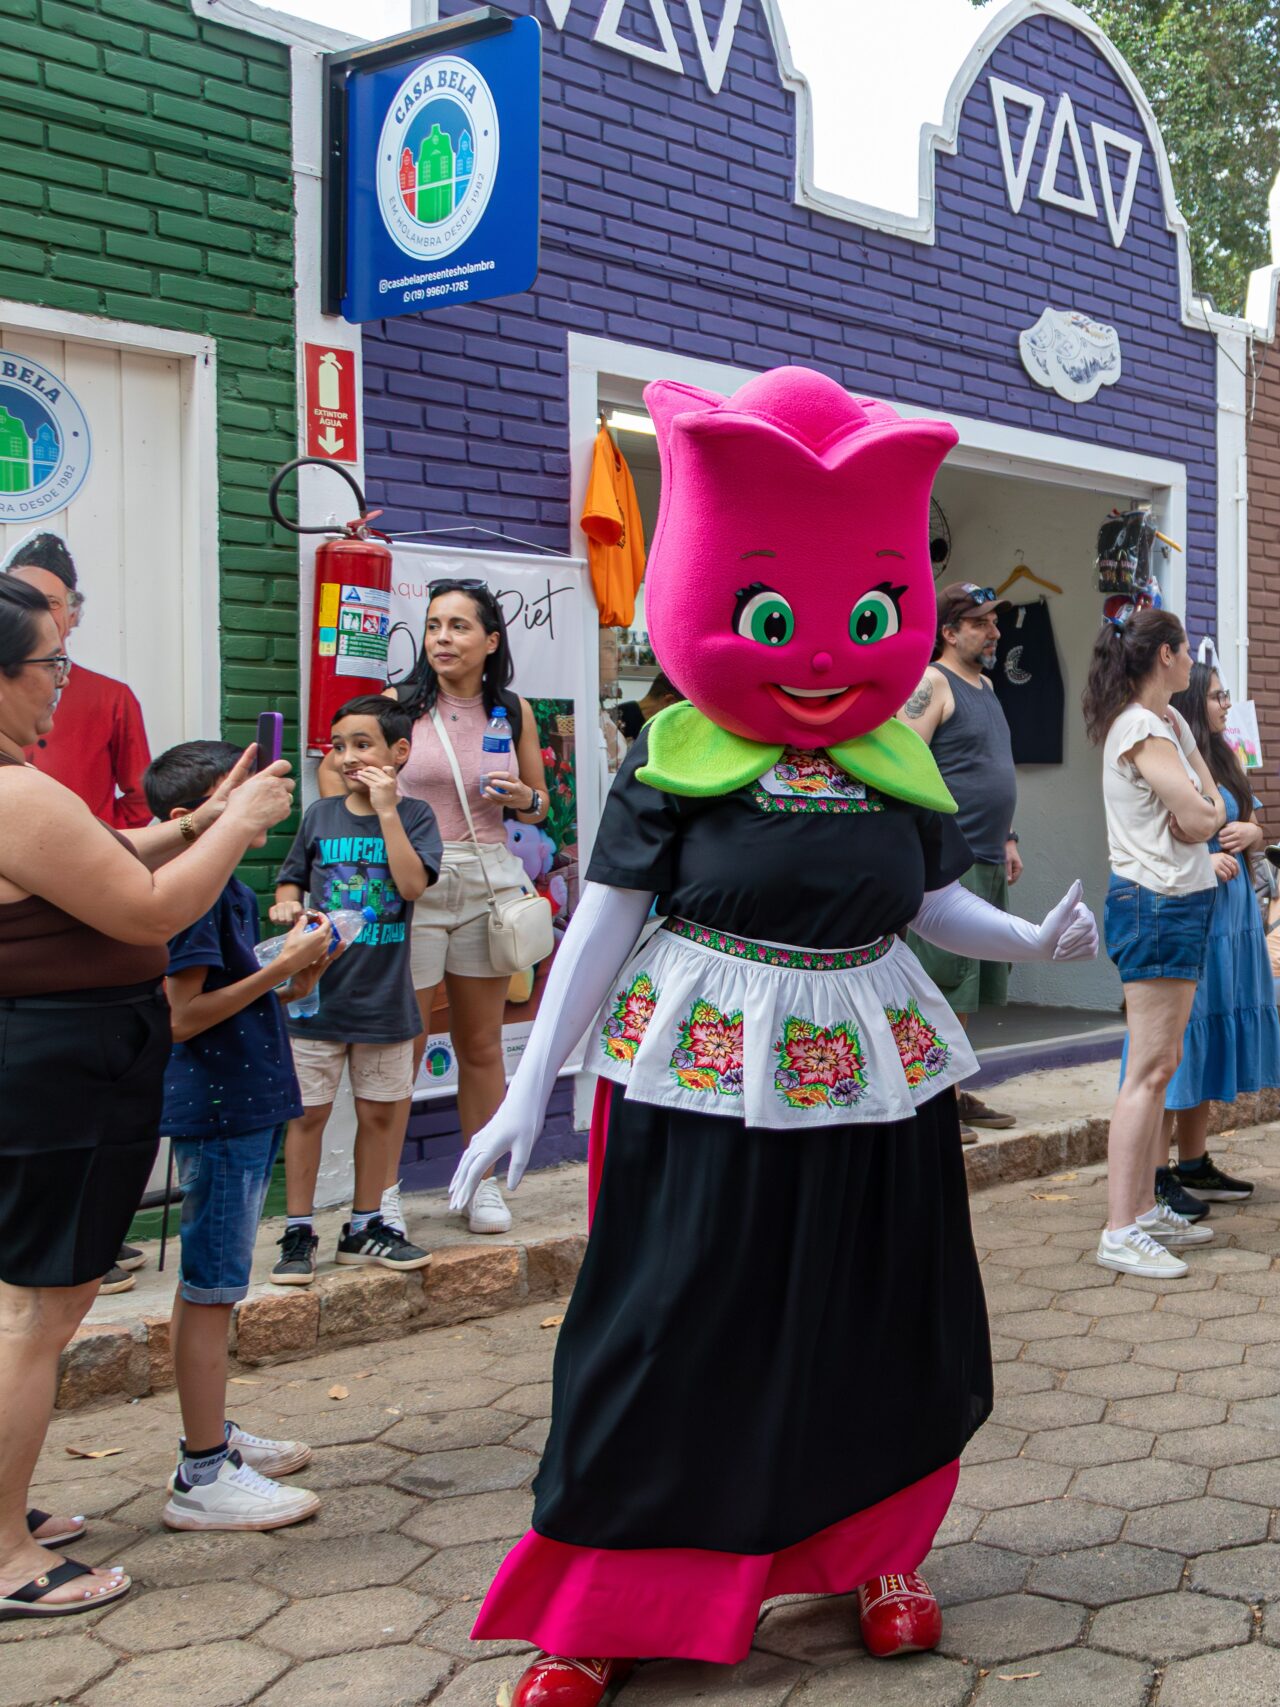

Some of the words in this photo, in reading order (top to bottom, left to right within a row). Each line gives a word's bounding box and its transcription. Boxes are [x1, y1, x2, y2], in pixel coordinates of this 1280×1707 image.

[395, 75, 434, 124] CASA
[437, 70, 477, 104] BELA
[389, 196, 399, 216] EM
[397, 216, 443, 247] HOLAMBRA
[444, 206, 473, 242] DESDE
[471, 172, 486, 204] 1982
[411, 289, 425, 302] (19)
[426, 280, 469, 298] 99607-1783
[1, 360, 61, 405] BELA
[313, 408, 348, 420] EXTINTOR
[19, 488, 60, 512] DESDE
[57, 464, 76, 489] 1982
[319, 836, 388, 867] MINECR
